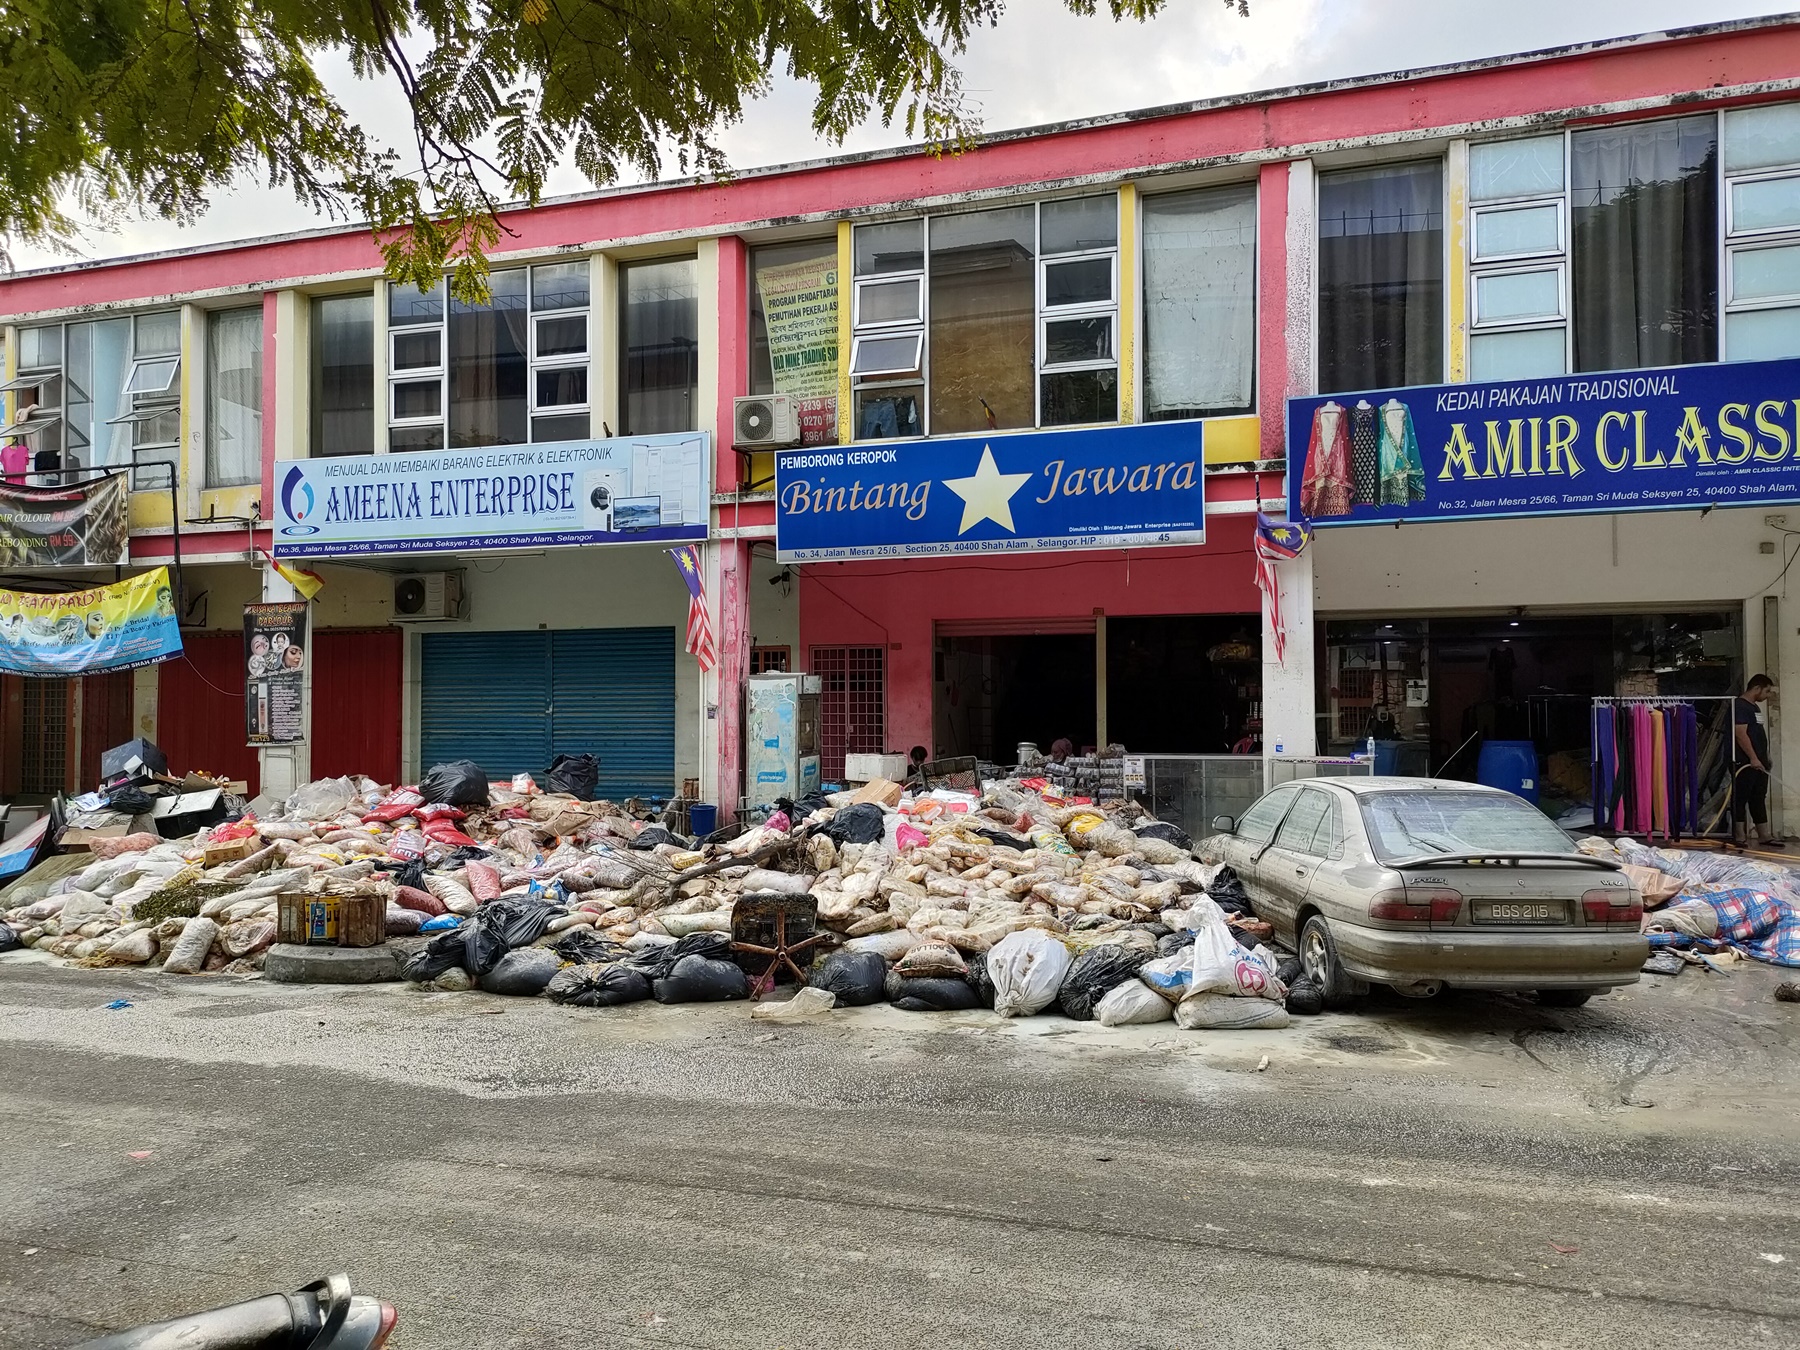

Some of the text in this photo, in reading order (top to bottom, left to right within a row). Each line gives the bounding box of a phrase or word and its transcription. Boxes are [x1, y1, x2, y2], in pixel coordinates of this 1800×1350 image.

[769, 295, 796, 308] PROGRAM
[768, 308, 801, 323] PEMUTIHAN
[803, 304, 828, 316] PEKERJA
[801, 347, 827, 365] TRADING
[1436, 375, 1680, 412] KEDAI PAKAJAN TRADISIONAL
[803, 400, 821, 411] 2239
[804, 416, 822, 426] 0270
[805, 431, 823, 441] 3961
[1437, 414, 1586, 482] AMIR
[325, 447, 612, 477] MENJUAL DAN MEMBAIKI BARANG ELEKTRIK & ELEKTRONIK
[780, 450, 897, 470] PEMBORONG KEROPOK
[325, 472, 576, 524] AMEENA ENTERPRISE
[782, 460, 1197, 521] Bintang Jawara
[1438, 484, 1797, 509] No.32, Jalan Mesra 25/66, Taman Sri Muda Seksyen 25, 40400 Shah Alam,
[15, 513, 51, 522] COLOUR
[50, 535, 61, 546] RM
[435, 540, 467, 548] Seksyen
[557, 535, 594, 543] Selangor.
[810, 550, 821, 558] 34,
[824, 549, 845, 557] Jalan
[850, 548, 874, 556] Mesra
[905, 545, 937, 553] Section
[940, 544, 952, 553] 25,
[954, 543, 979, 551] 40400
[982, 541, 1004, 550] Shah
[1006, 540, 1029, 548] Alam
[151, 655, 167, 664] ALAM
[1491, 904, 1548, 918] BGS 2115
